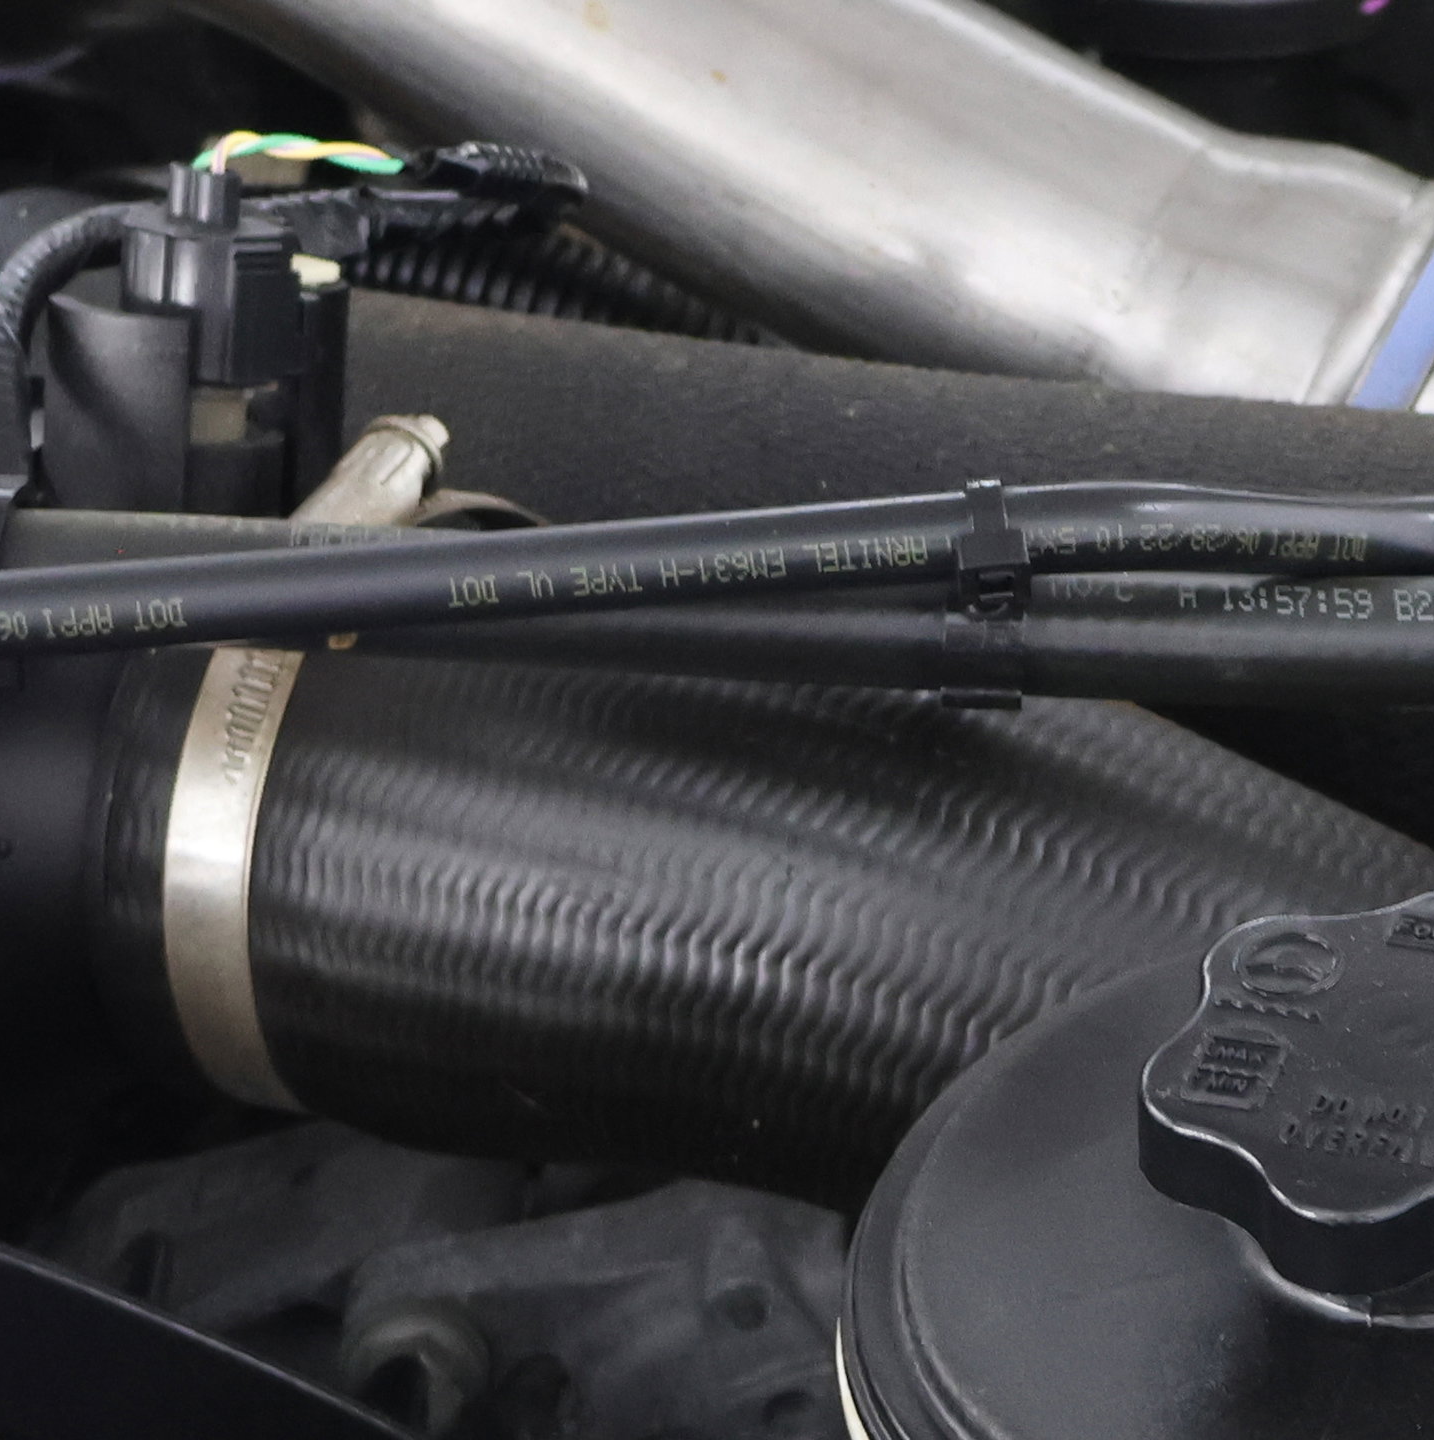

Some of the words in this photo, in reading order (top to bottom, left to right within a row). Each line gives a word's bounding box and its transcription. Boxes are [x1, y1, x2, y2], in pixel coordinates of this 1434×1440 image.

[447, 574, 498, 608] DOT
[571, 560, 643, 596] TYPE
[133, 597, 187, 632] DOT
[1222, 585, 1374, 620] 13:57:59
